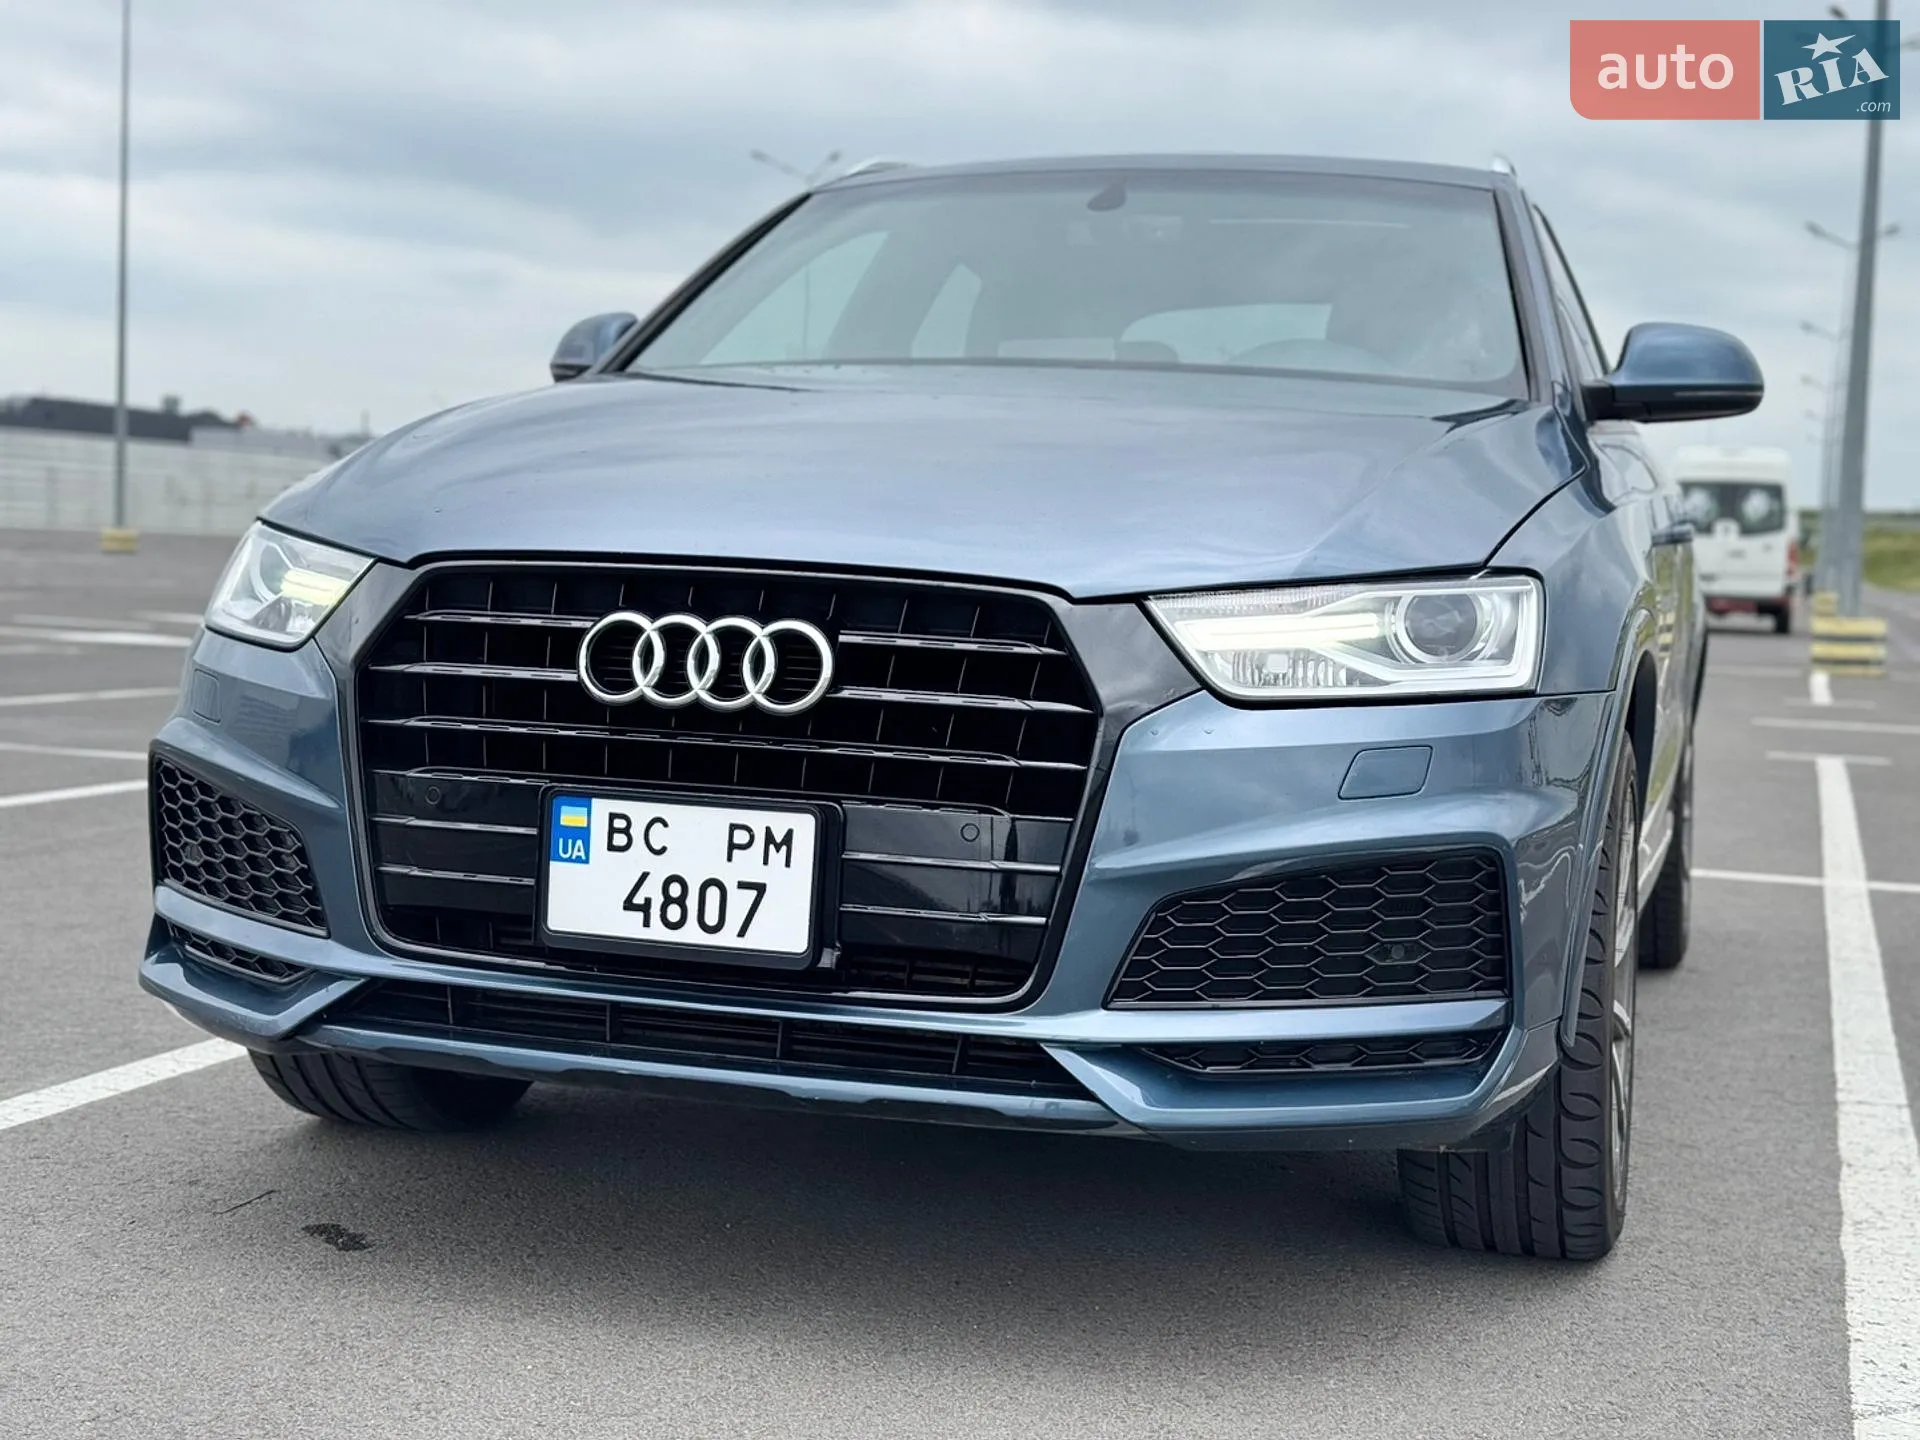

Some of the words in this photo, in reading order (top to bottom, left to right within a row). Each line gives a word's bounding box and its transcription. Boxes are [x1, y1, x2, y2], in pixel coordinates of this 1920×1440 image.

[558, 837, 587, 861] UA
[606, 811, 670, 856] BC
[726, 822, 794, 868] PM
[622, 871, 767, 938] 4807
